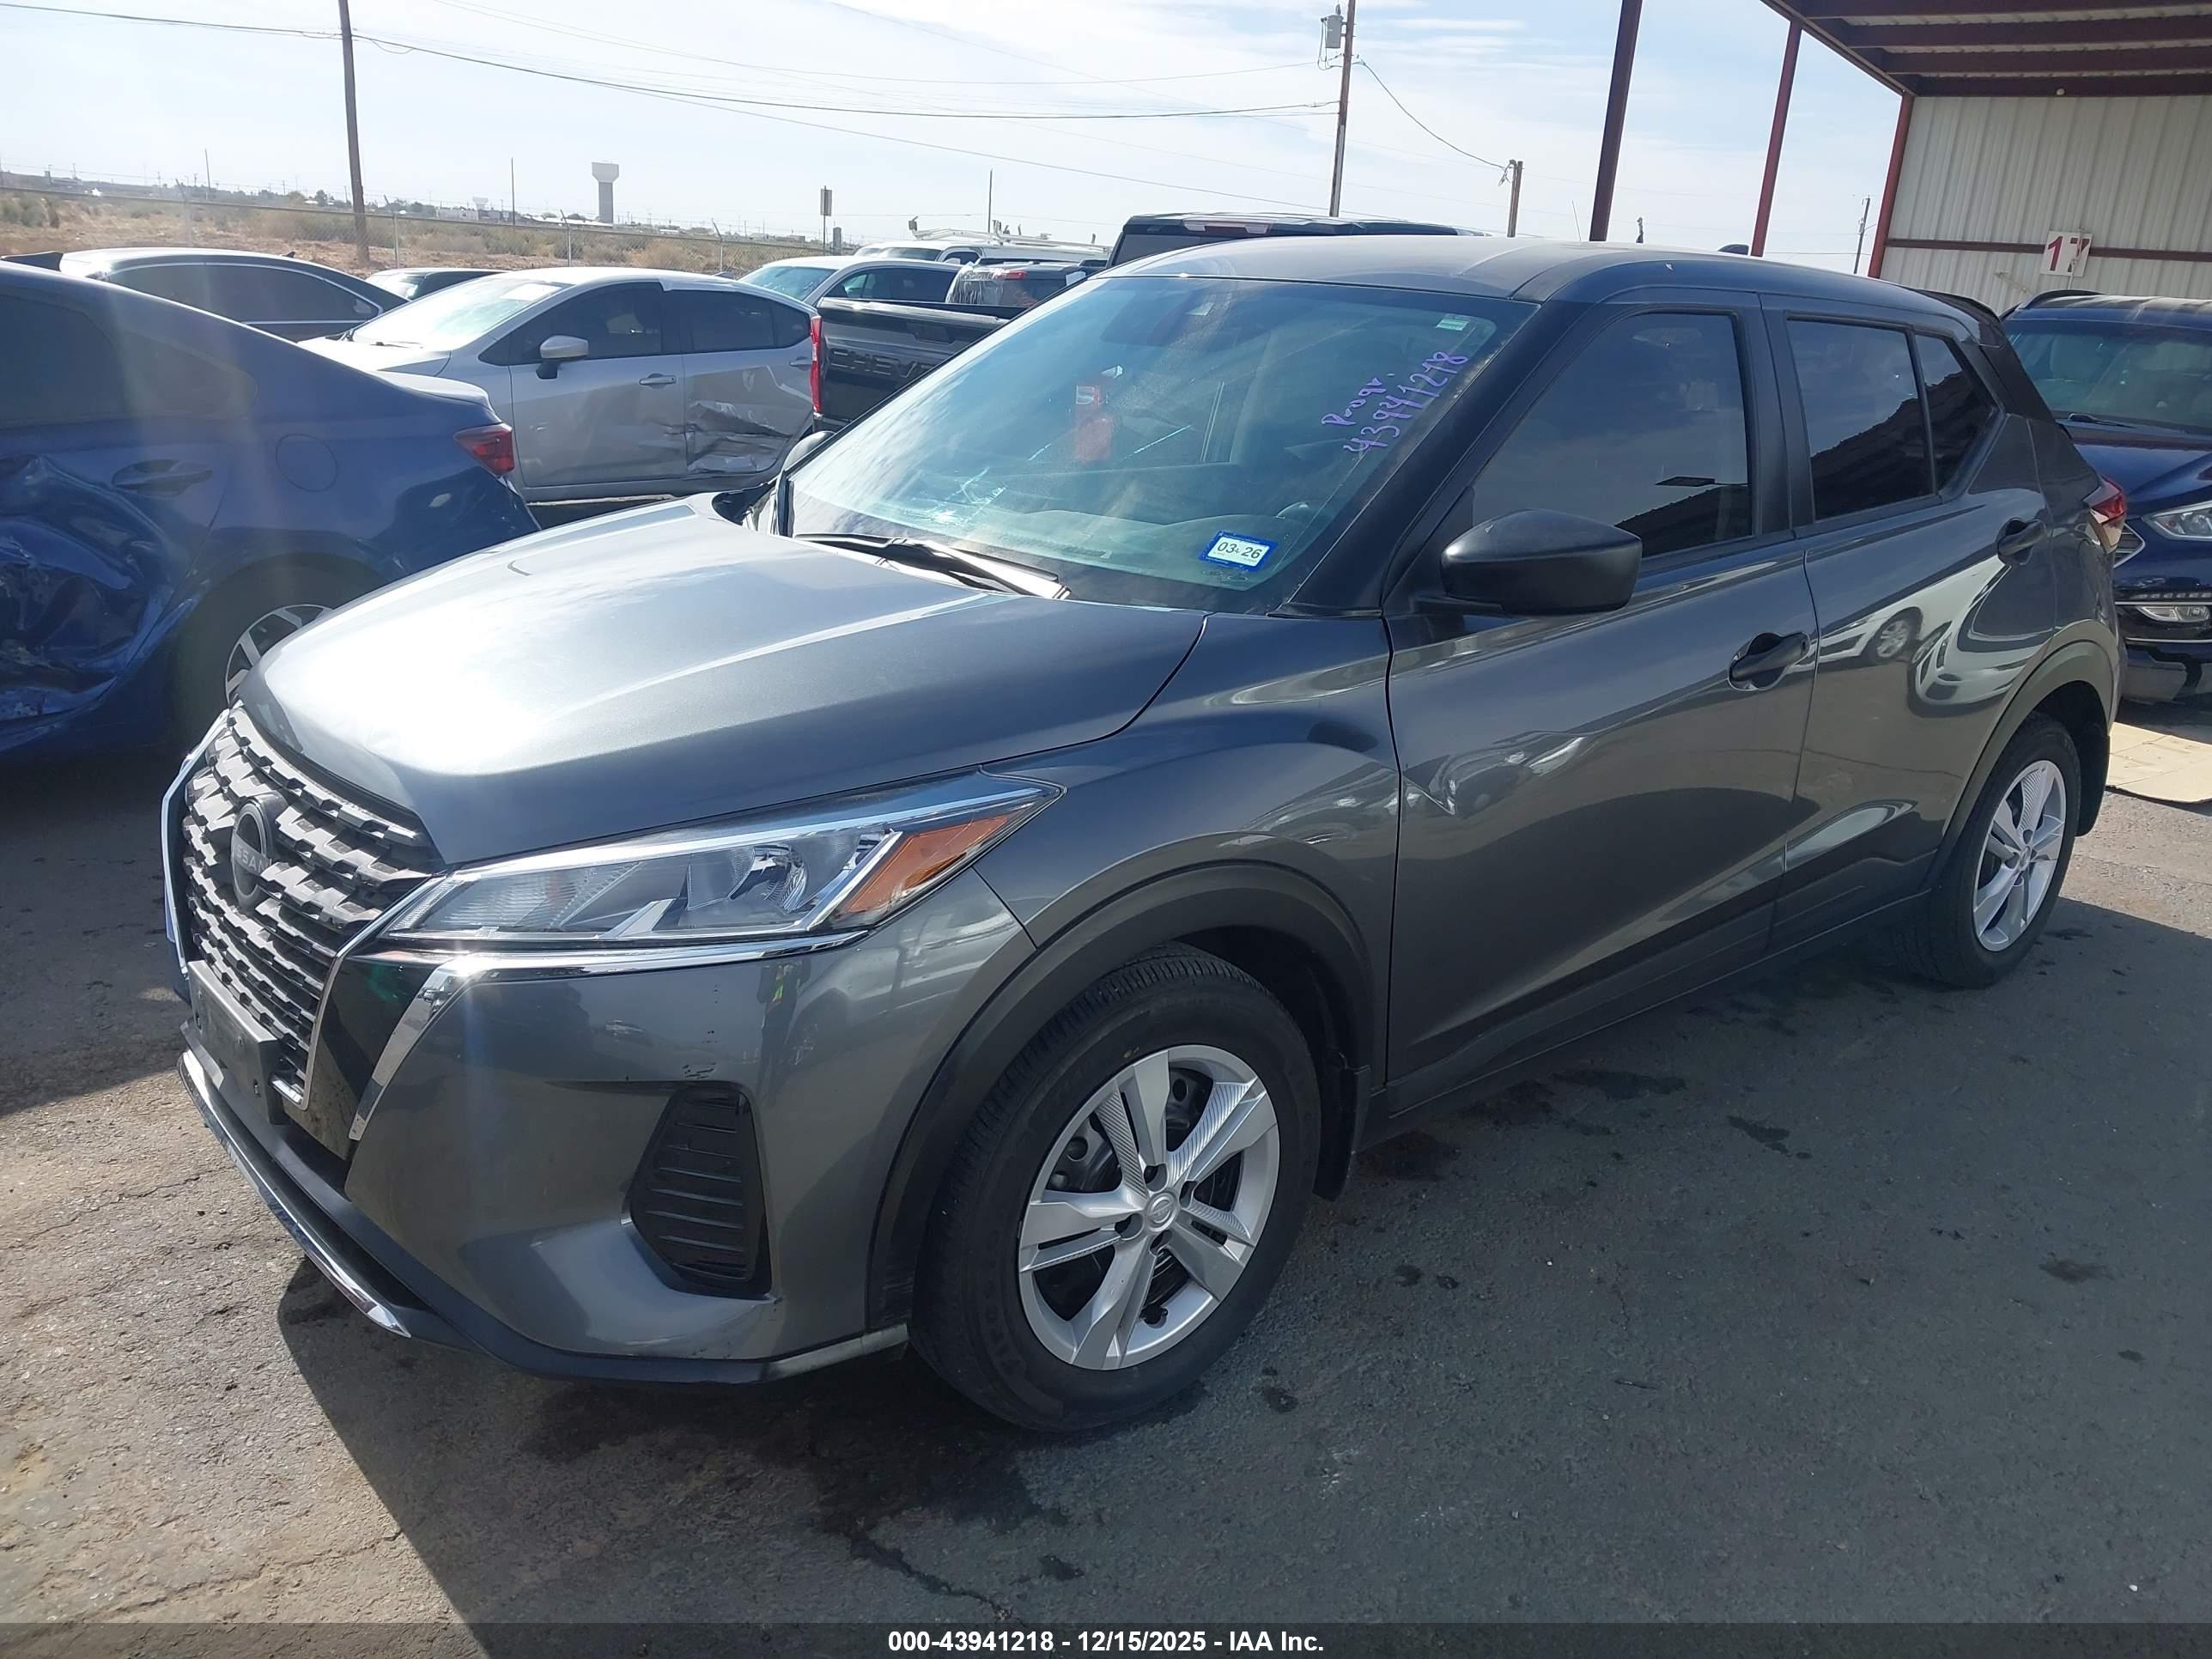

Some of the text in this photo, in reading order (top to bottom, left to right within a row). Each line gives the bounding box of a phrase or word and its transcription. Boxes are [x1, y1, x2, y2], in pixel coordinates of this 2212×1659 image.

[2047, 235, 2090, 273] 17
[1217, 541, 1262, 559] 03 26
